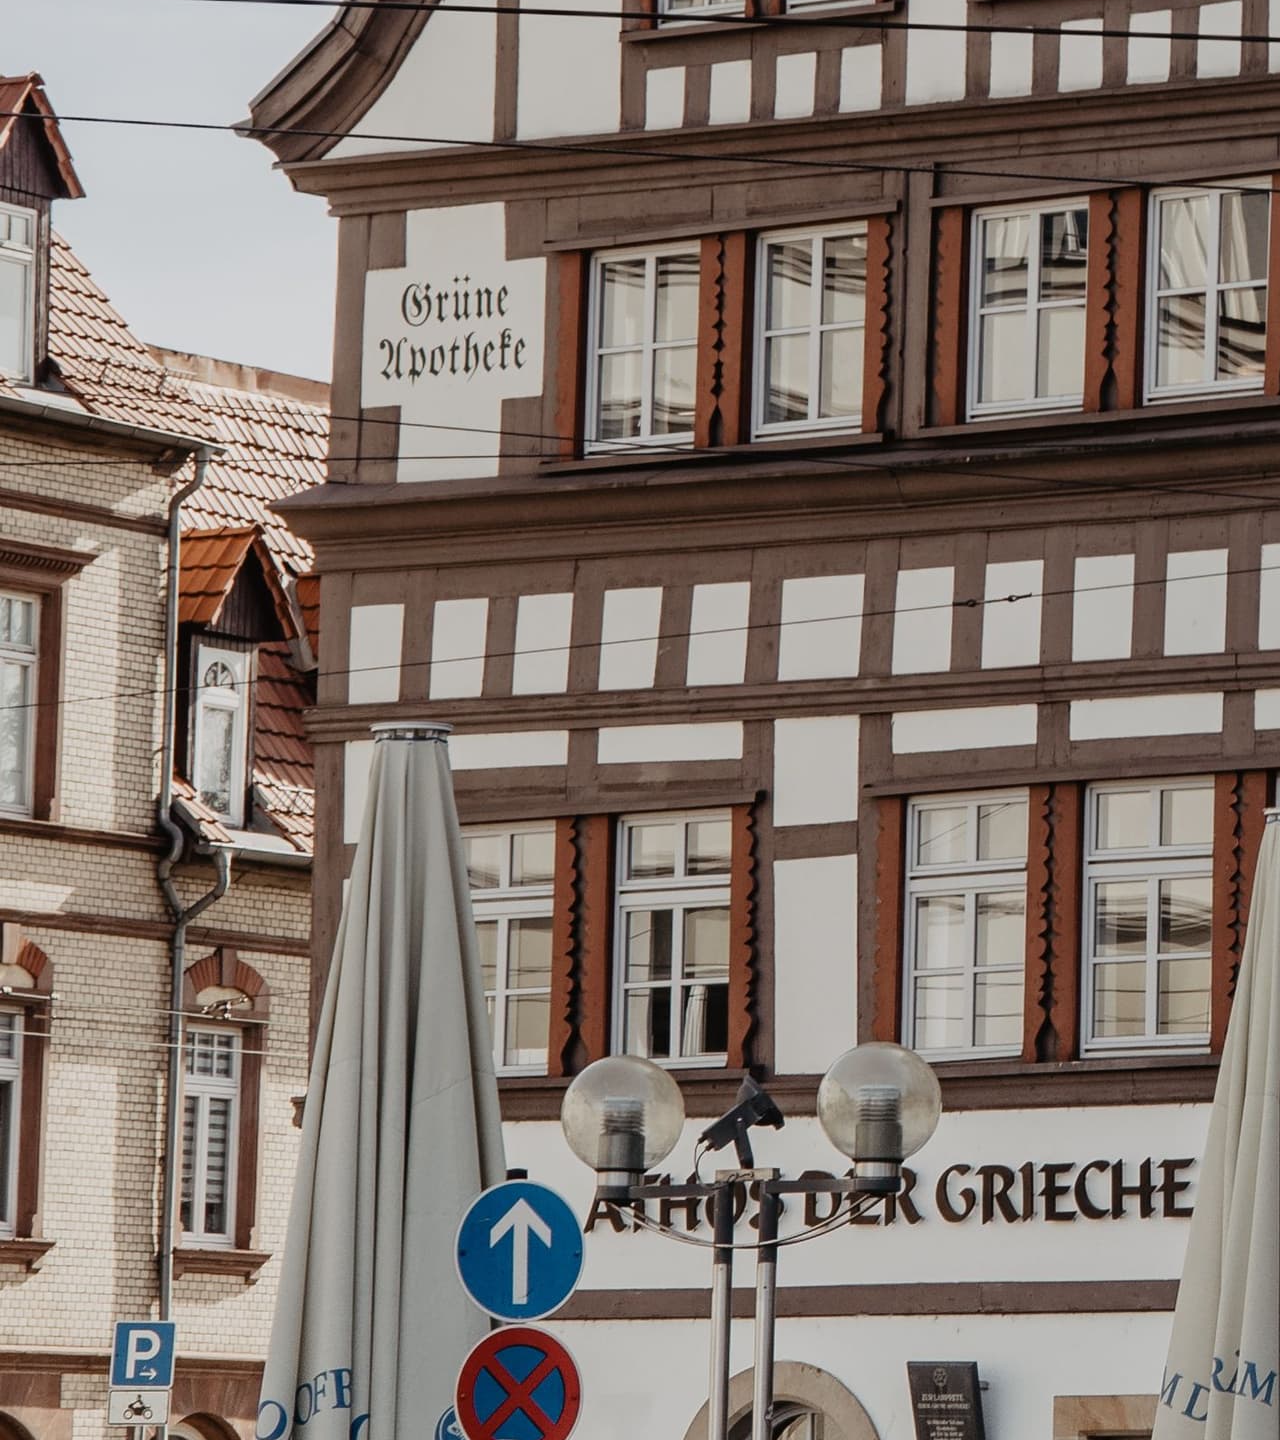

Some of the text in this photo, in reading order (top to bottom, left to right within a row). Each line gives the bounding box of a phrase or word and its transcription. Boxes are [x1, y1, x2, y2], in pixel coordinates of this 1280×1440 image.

[402, 274, 508, 327] Grüne
[379, 328, 527, 387] Apotheke
[935, 1156, 1196, 1226] GRIECHE
[125, 1329, 161, 1380] P
